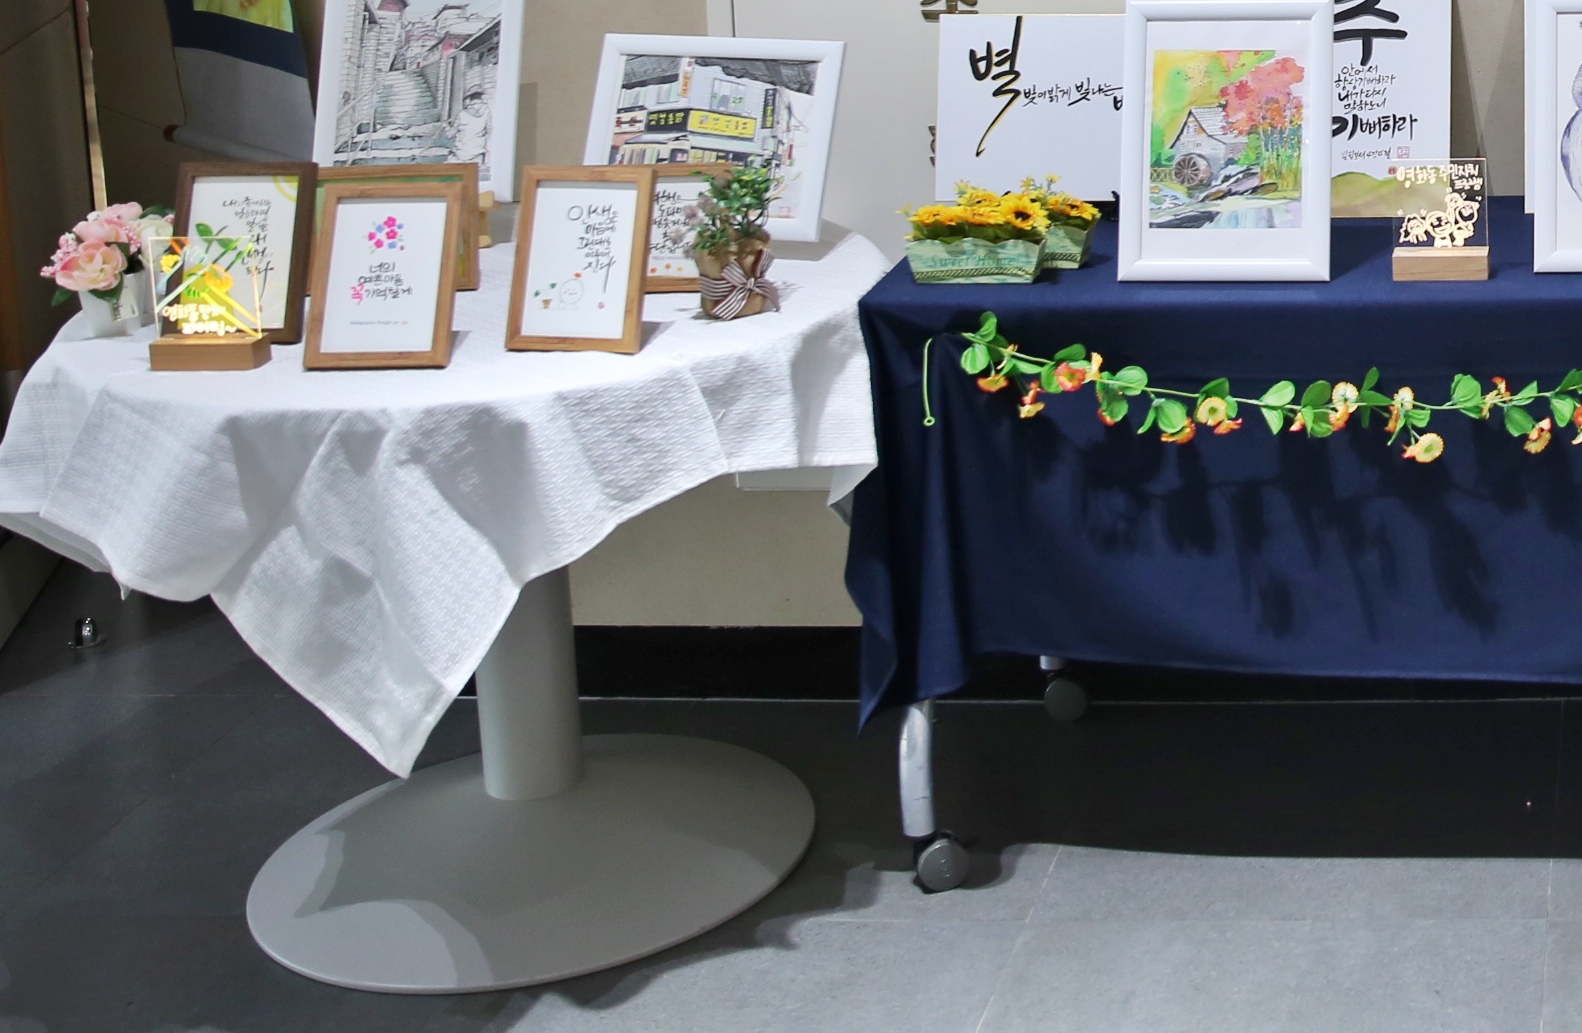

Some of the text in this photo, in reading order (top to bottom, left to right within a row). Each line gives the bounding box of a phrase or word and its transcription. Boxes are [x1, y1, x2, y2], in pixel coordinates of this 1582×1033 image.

[1341, 63, 1378, 77] 안에서
[968, 15, 1022, 158] 별
[1067, 77, 1123, 106] 빛나는
[1332, 113, 1418, 141] 기뻐하라
